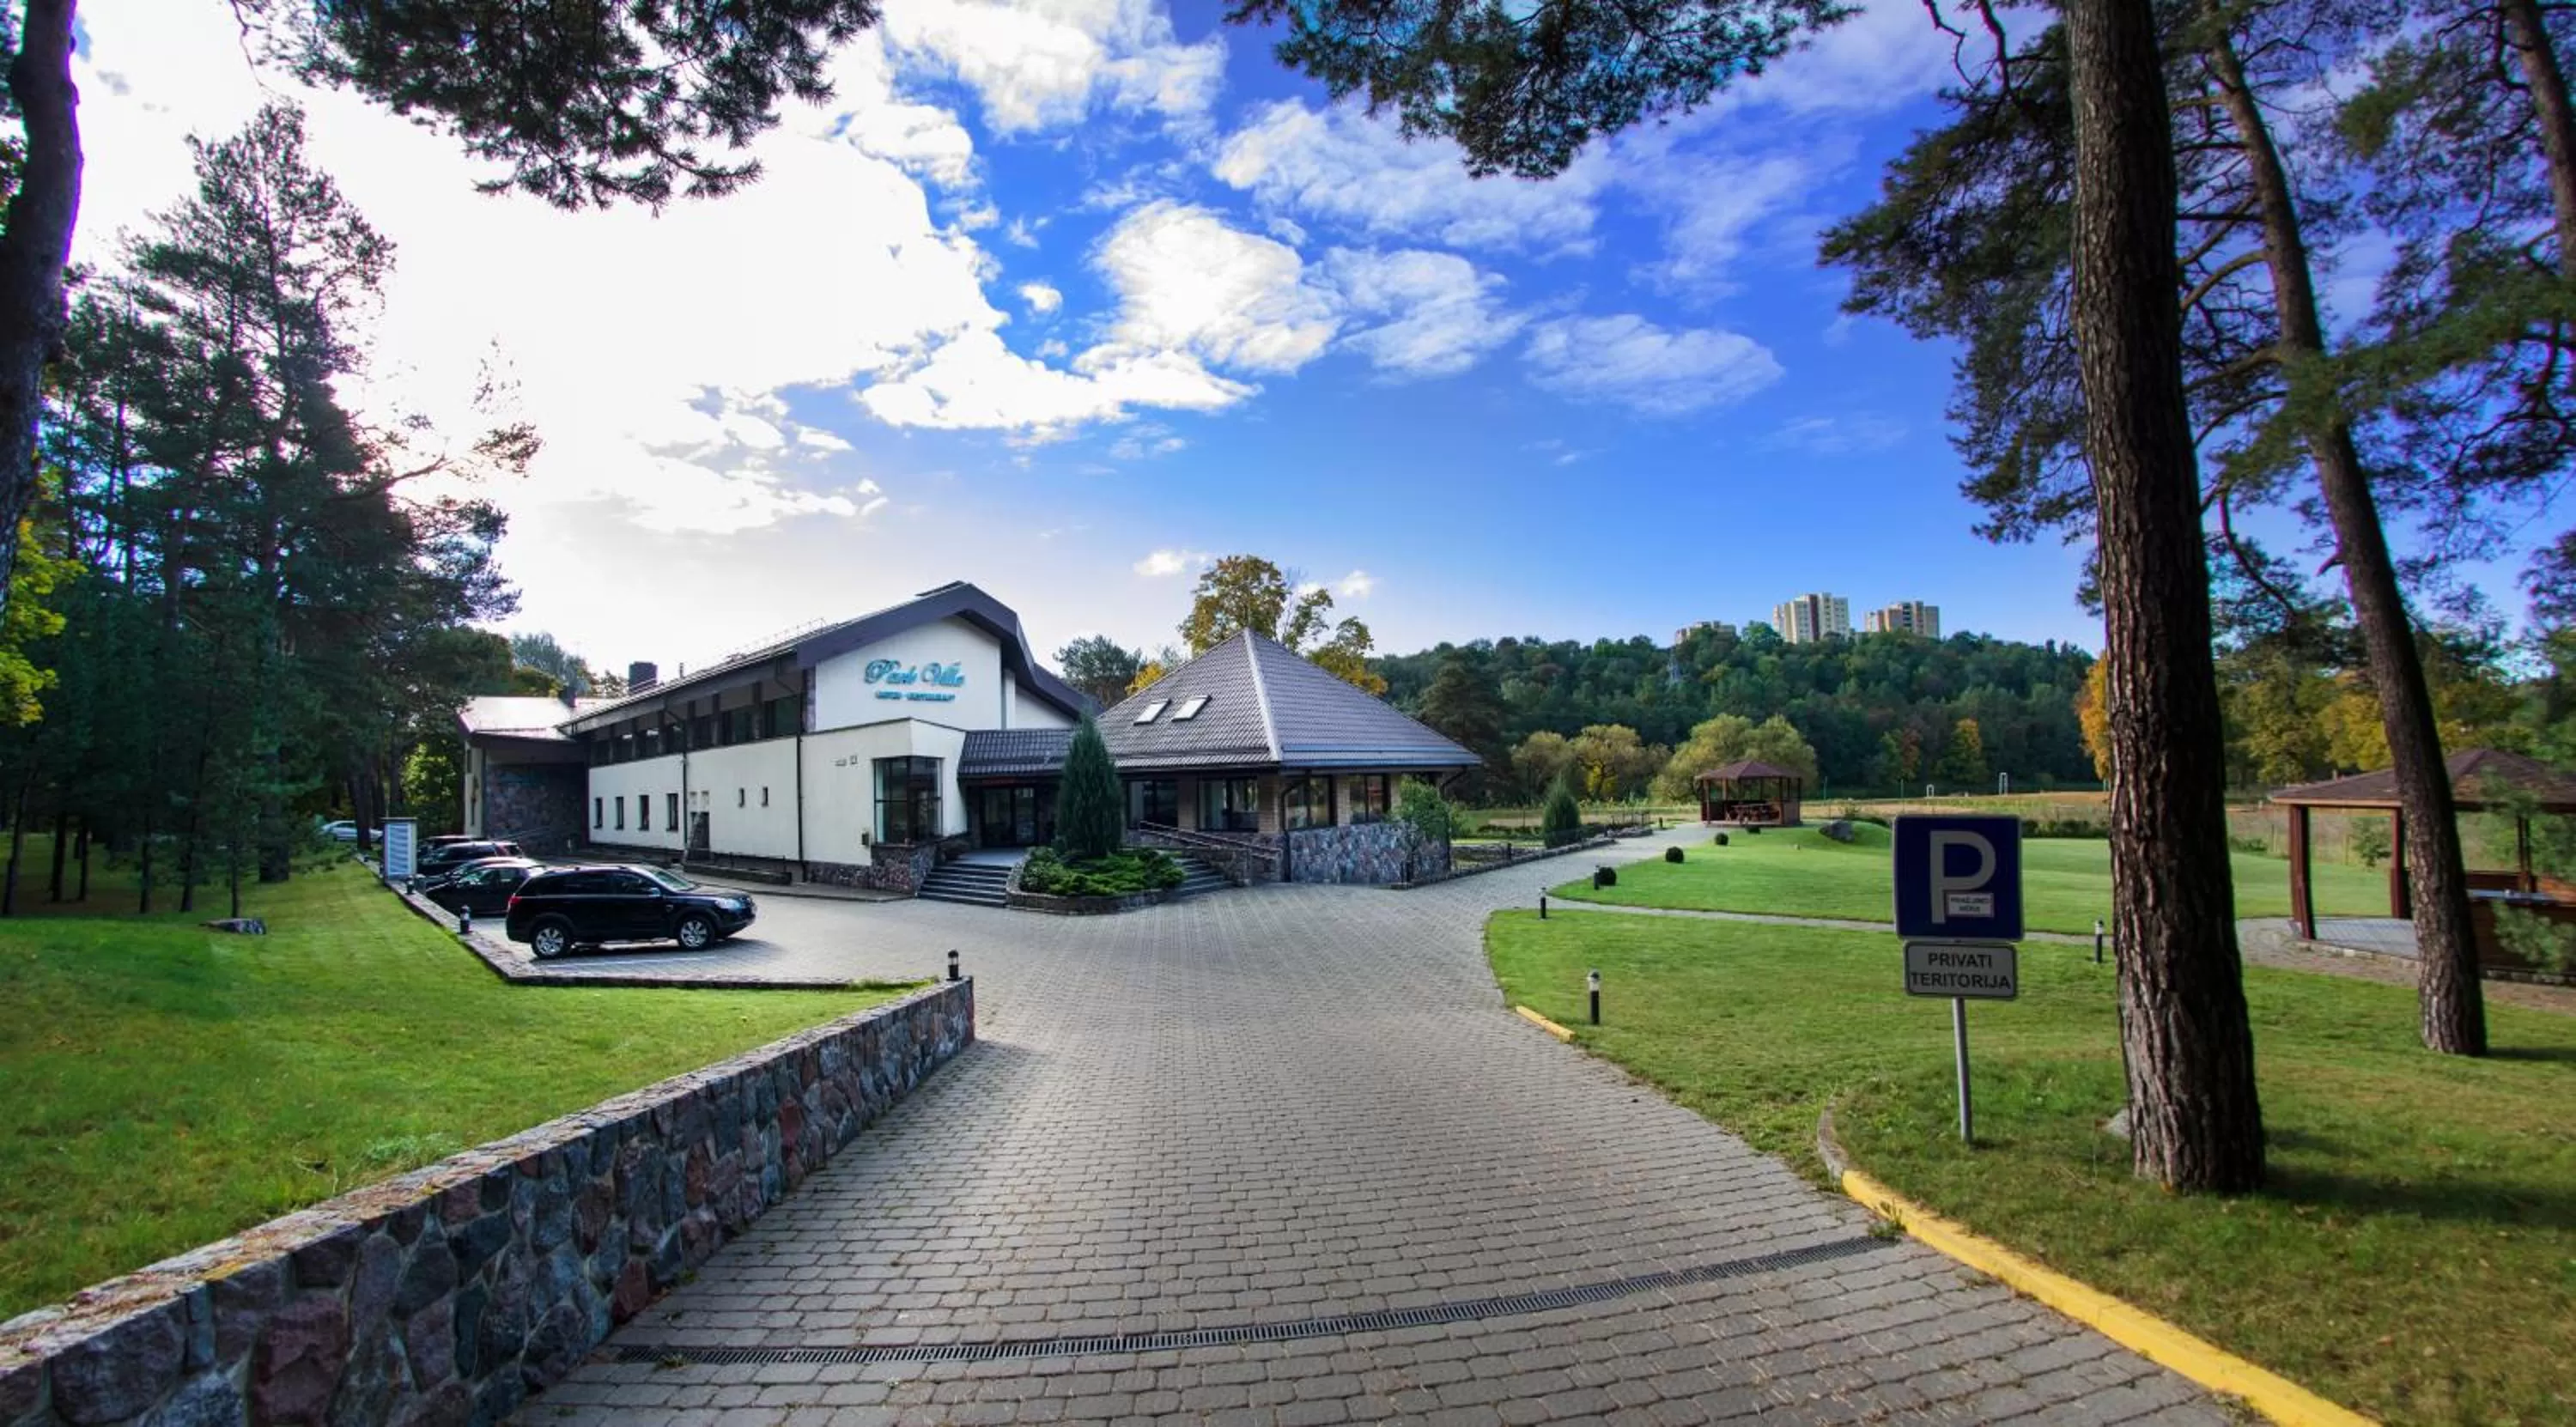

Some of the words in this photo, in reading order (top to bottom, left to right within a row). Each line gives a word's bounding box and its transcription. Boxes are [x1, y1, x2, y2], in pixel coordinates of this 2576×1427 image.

[1929, 830, 1996, 924] P
[1928, 952, 1993, 969] PRIVATI
[1911, 972, 2011, 989] TERITORIJA
